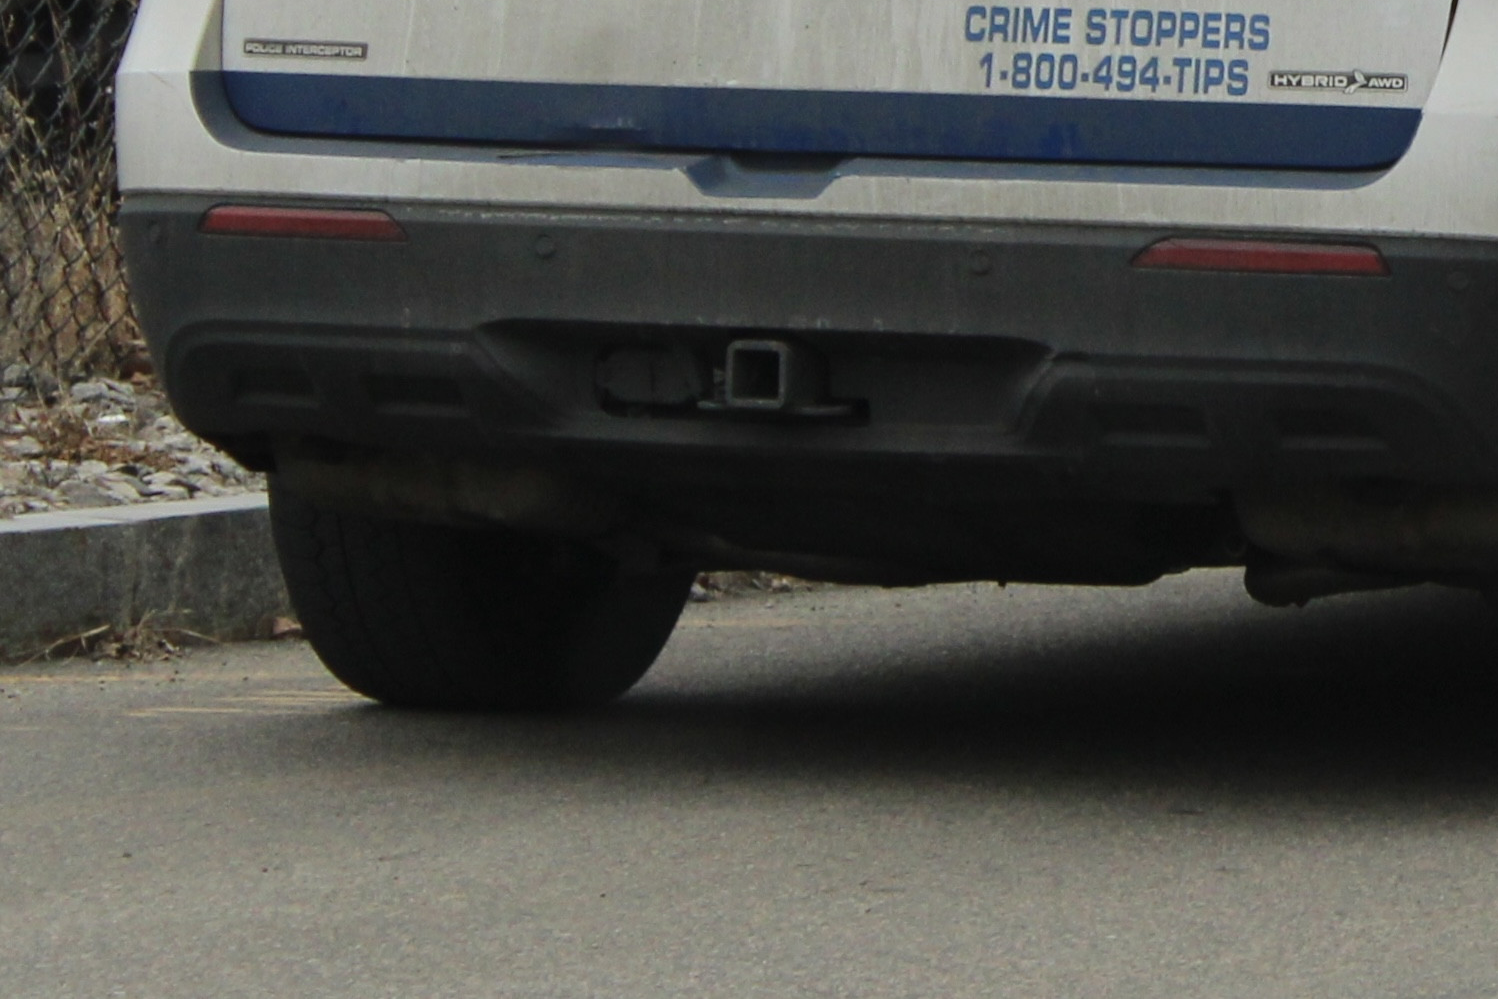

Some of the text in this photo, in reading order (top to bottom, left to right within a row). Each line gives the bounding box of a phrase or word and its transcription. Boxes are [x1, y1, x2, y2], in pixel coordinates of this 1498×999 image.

[964, 5, 1271, 51] CRIME STOPPERS
[285, 44, 363, 57] INTERCEPTOR
[980, 52, 1249, 97] 1-800-494-TIPS
[1273, 72, 1406, 91] HYBRID AWD
